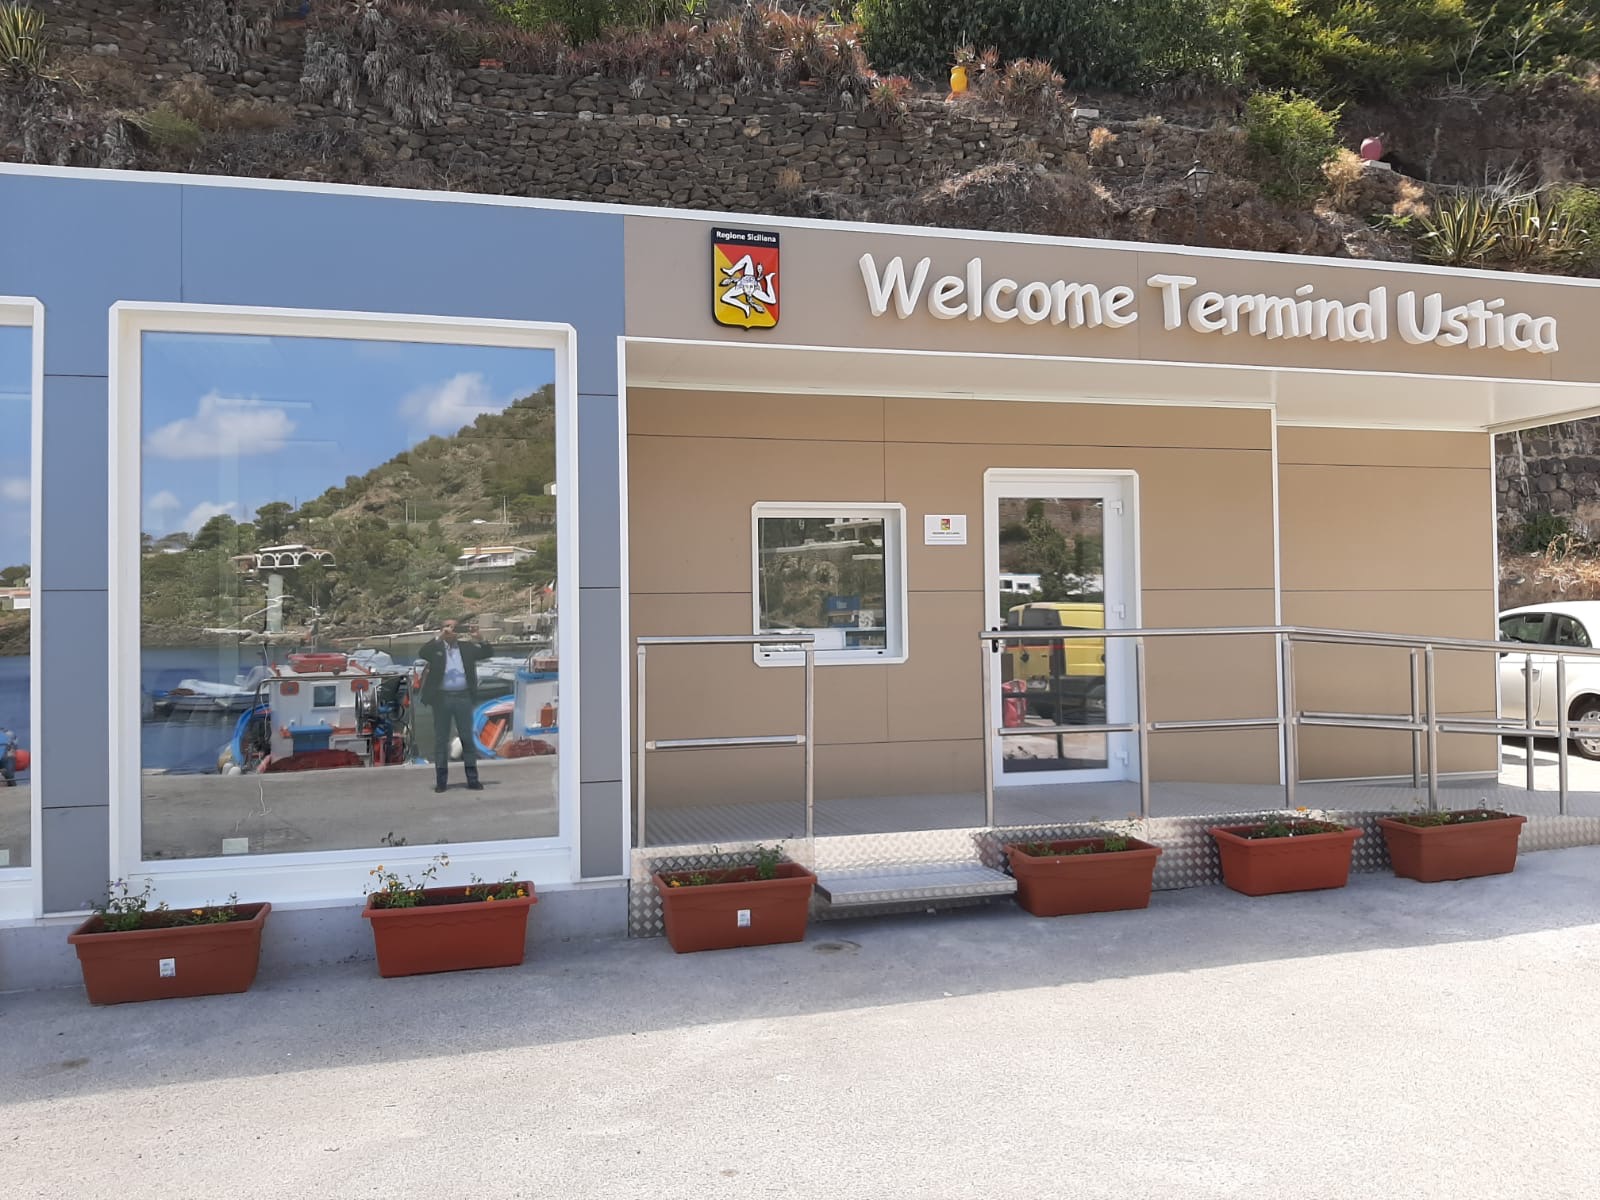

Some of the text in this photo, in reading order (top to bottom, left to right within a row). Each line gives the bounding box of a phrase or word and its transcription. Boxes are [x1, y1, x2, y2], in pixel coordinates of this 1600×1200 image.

[716, 231, 776, 242] Regione Siciliana
[859, 254, 1558, 354] Welcome Terminal Ustica
